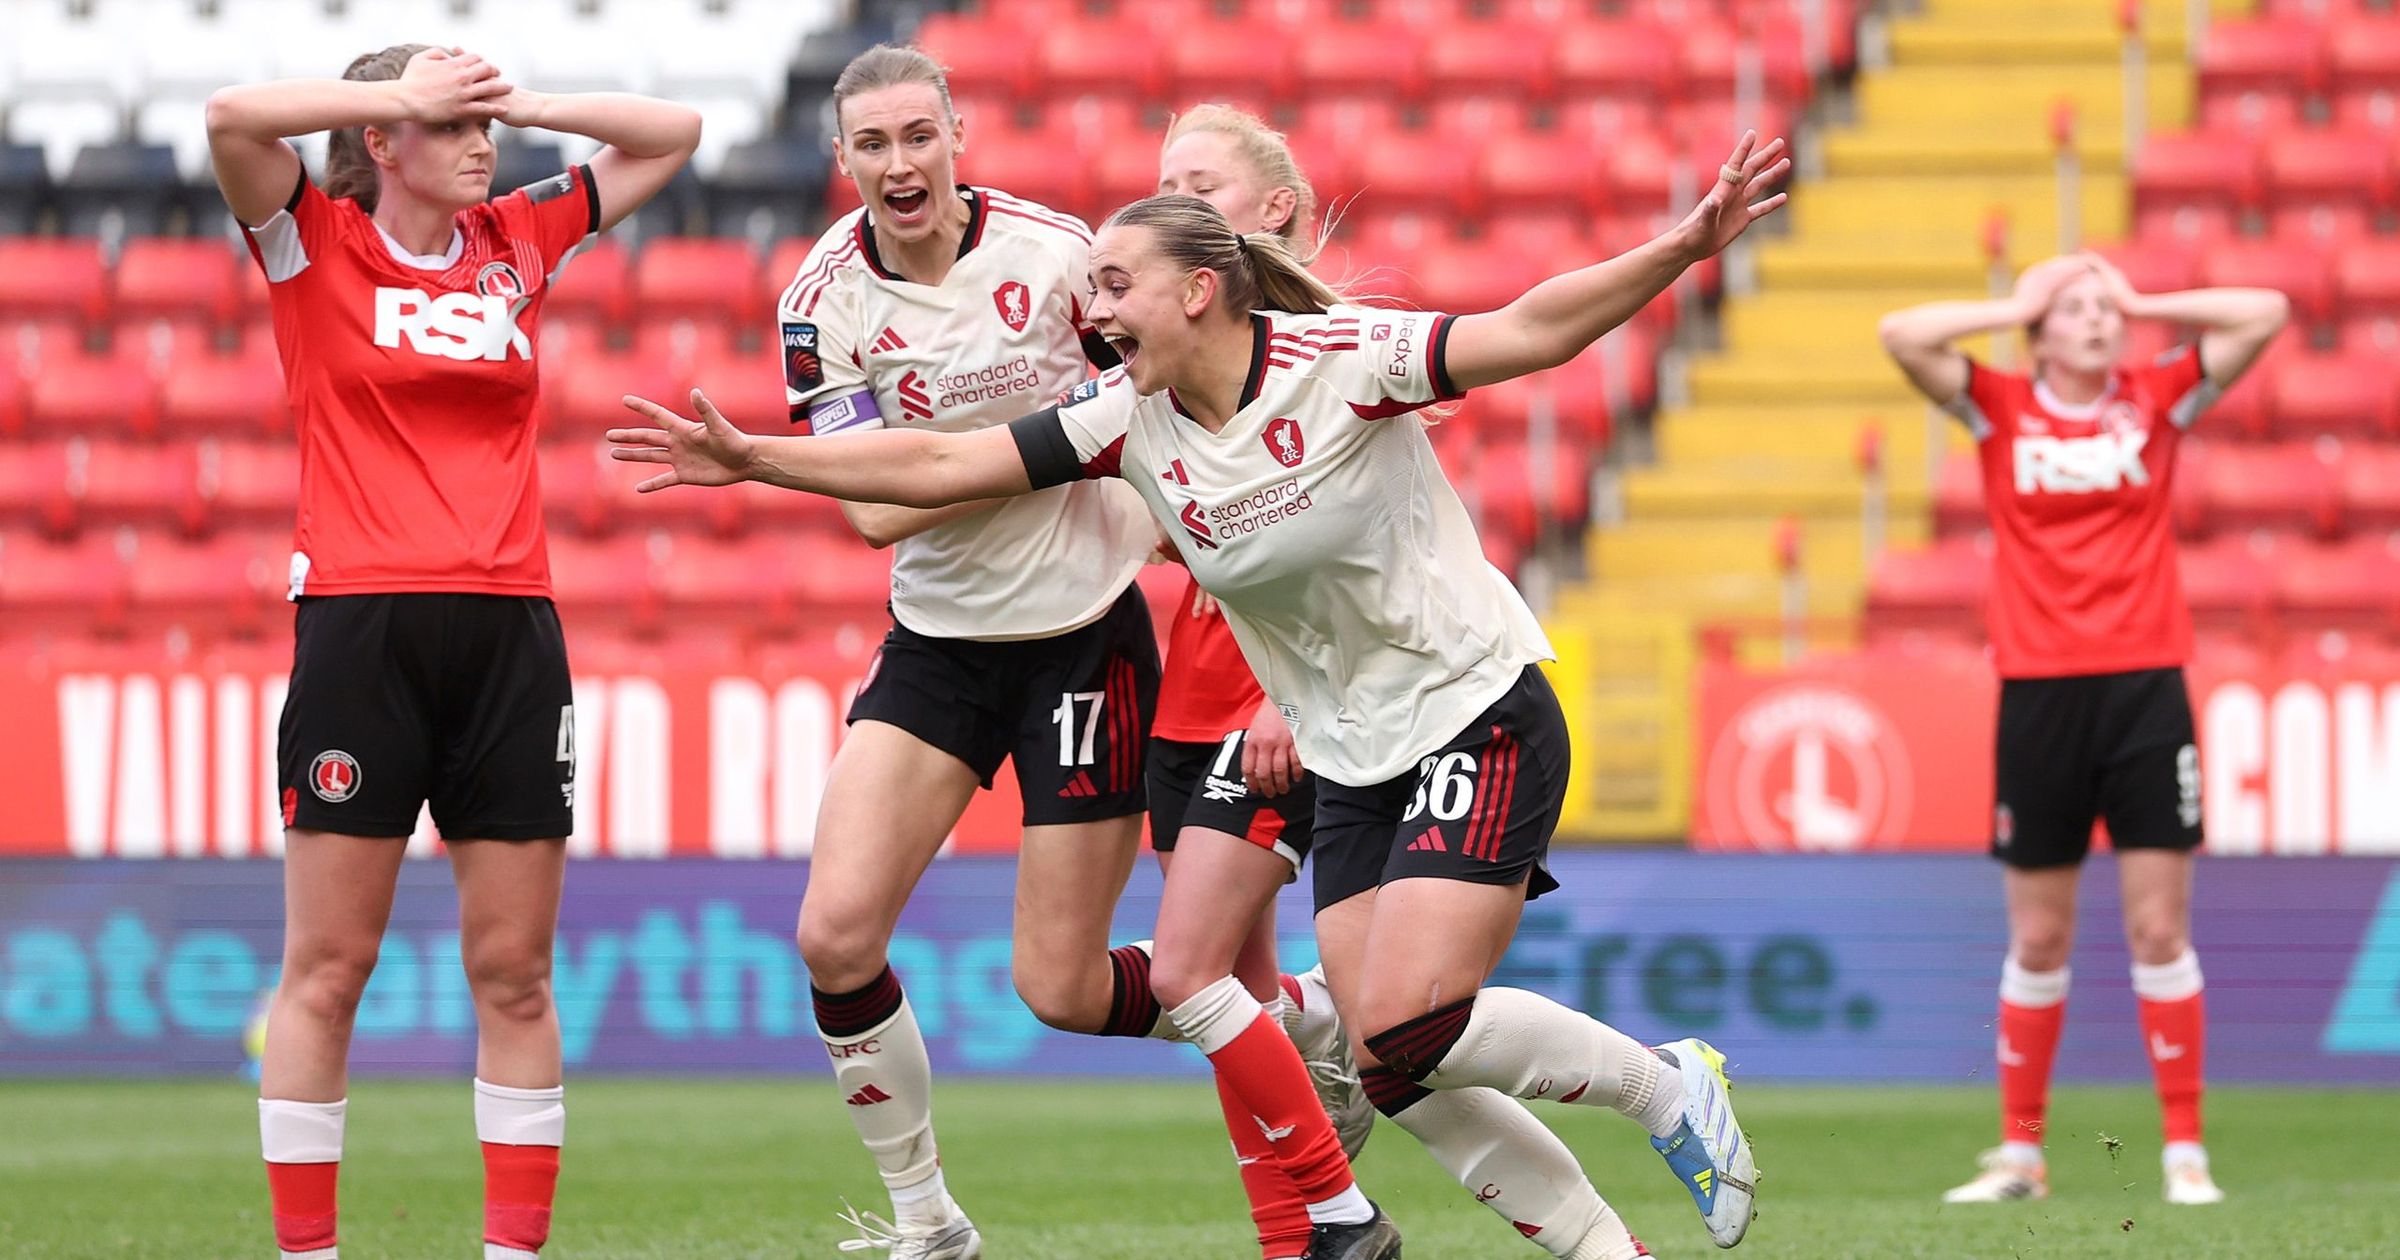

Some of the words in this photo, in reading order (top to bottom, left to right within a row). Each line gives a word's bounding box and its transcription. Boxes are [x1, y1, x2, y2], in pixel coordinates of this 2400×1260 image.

[373, 286, 533, 361] RSK
[937, 355, 1029, 392] standard
[940, 370, 1040, 408] chartered
[2012, 433, 2149, 495] RSK
[1210, 478, 1299, 523] standard
[1219, 491, 1313, 540] chartered
[1052, 691, 1106, 767] 17
[1402, 751, 1478, 823] 36
[825, 1039, 882, 1058] LFC
